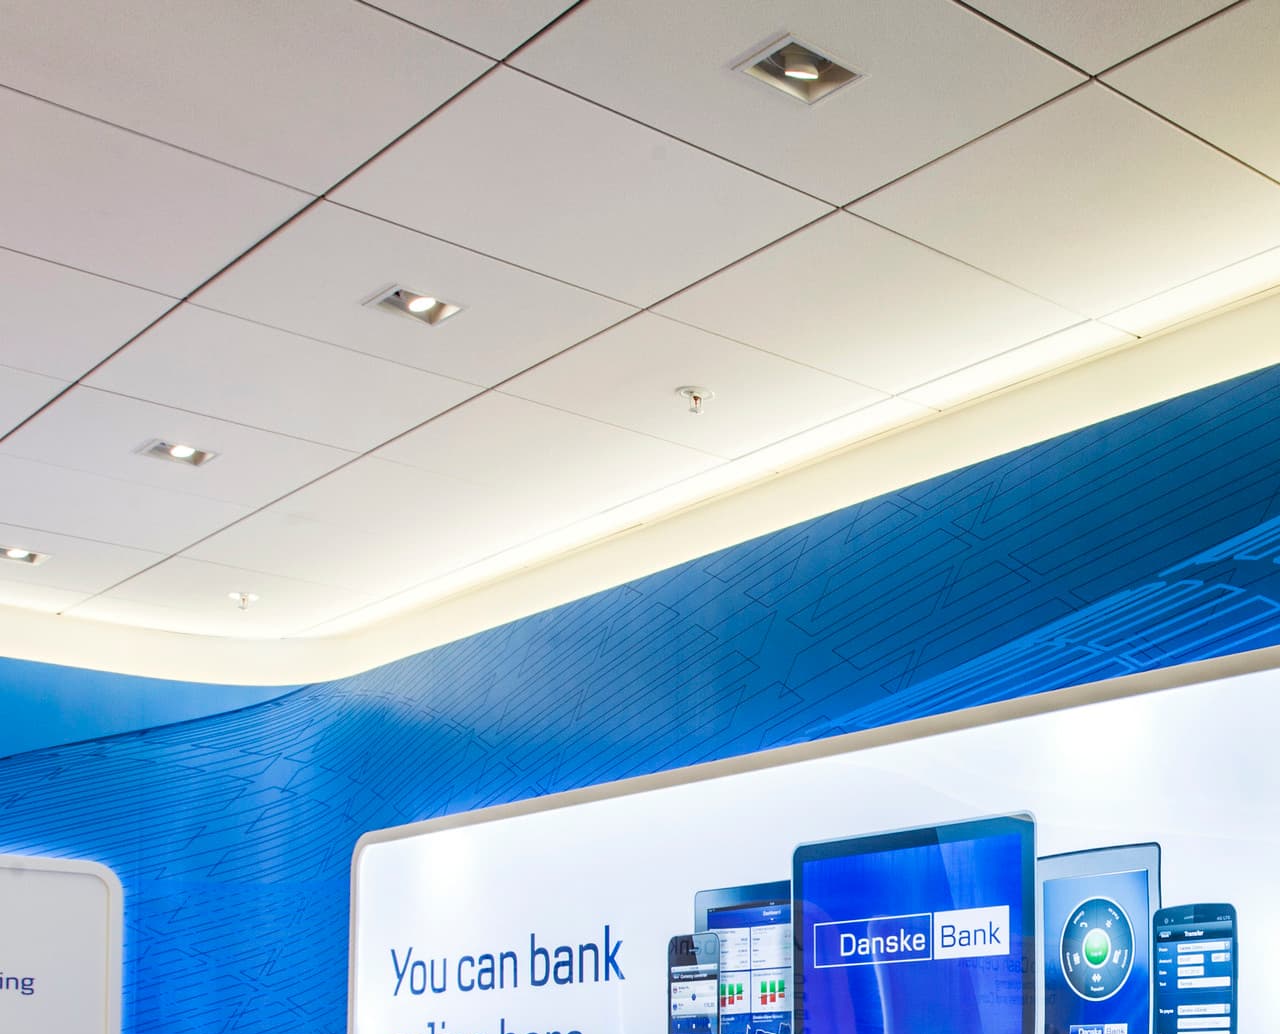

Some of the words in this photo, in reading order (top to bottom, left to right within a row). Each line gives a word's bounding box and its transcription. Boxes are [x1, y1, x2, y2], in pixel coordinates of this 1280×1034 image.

[390, 946, 447, 997] You
[457, 949, 518, 992] can
[530, 924, 626, 987] bank
[840, 928, 926, 957] Danske
[940, 920, 1001, 949] Bank
